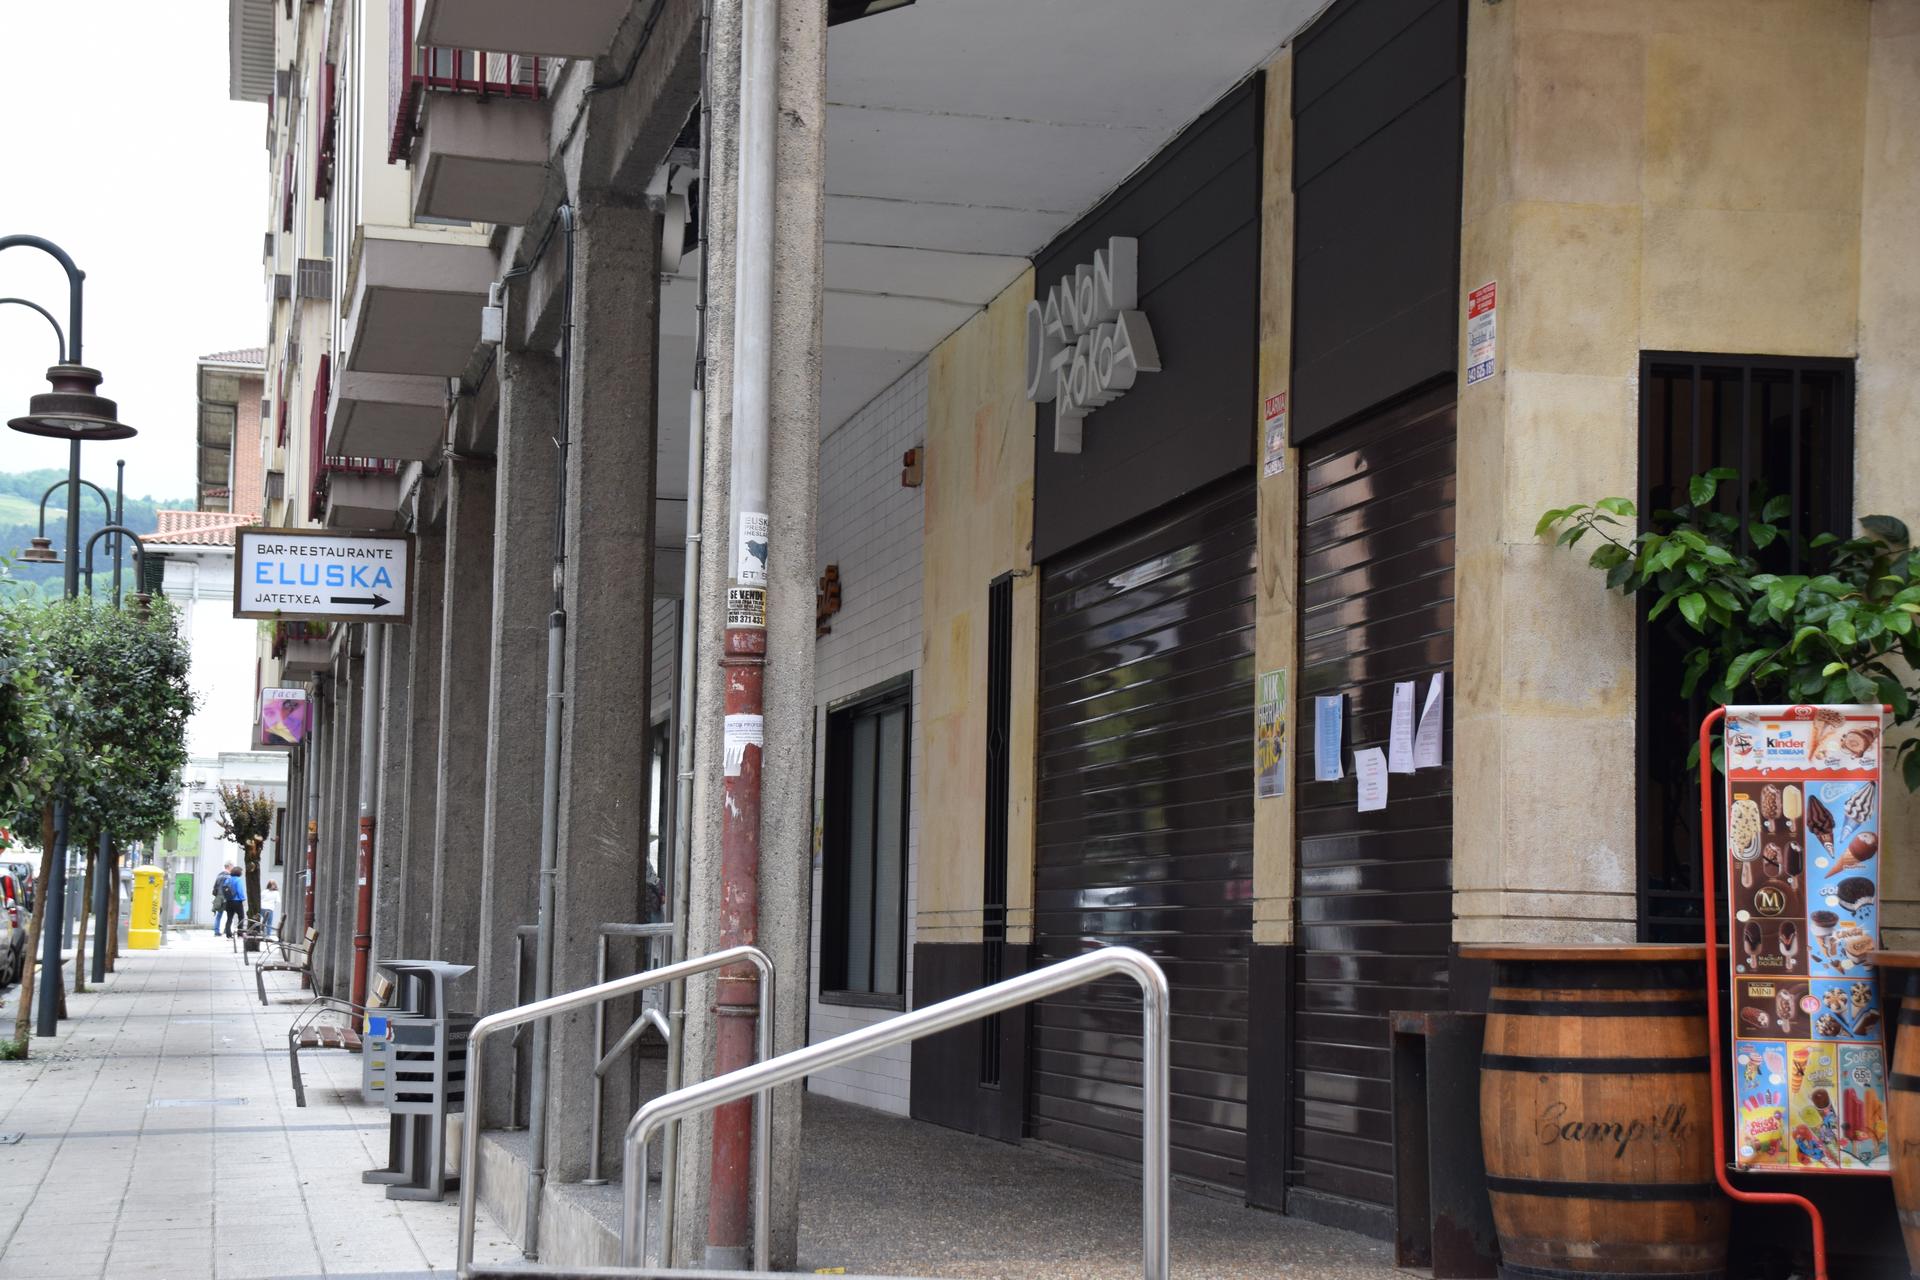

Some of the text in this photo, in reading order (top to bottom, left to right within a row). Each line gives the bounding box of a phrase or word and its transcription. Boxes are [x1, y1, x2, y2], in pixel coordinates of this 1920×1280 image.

[257, 544, 393, 559] BAR-RESTAURANTE
[256, 561, 393, 589] ELUSKA
[255, 593, 321, 604] JATETXEA
[730, 590, 738, 600] SE
[1751, 987, 1772, 995] MINI
